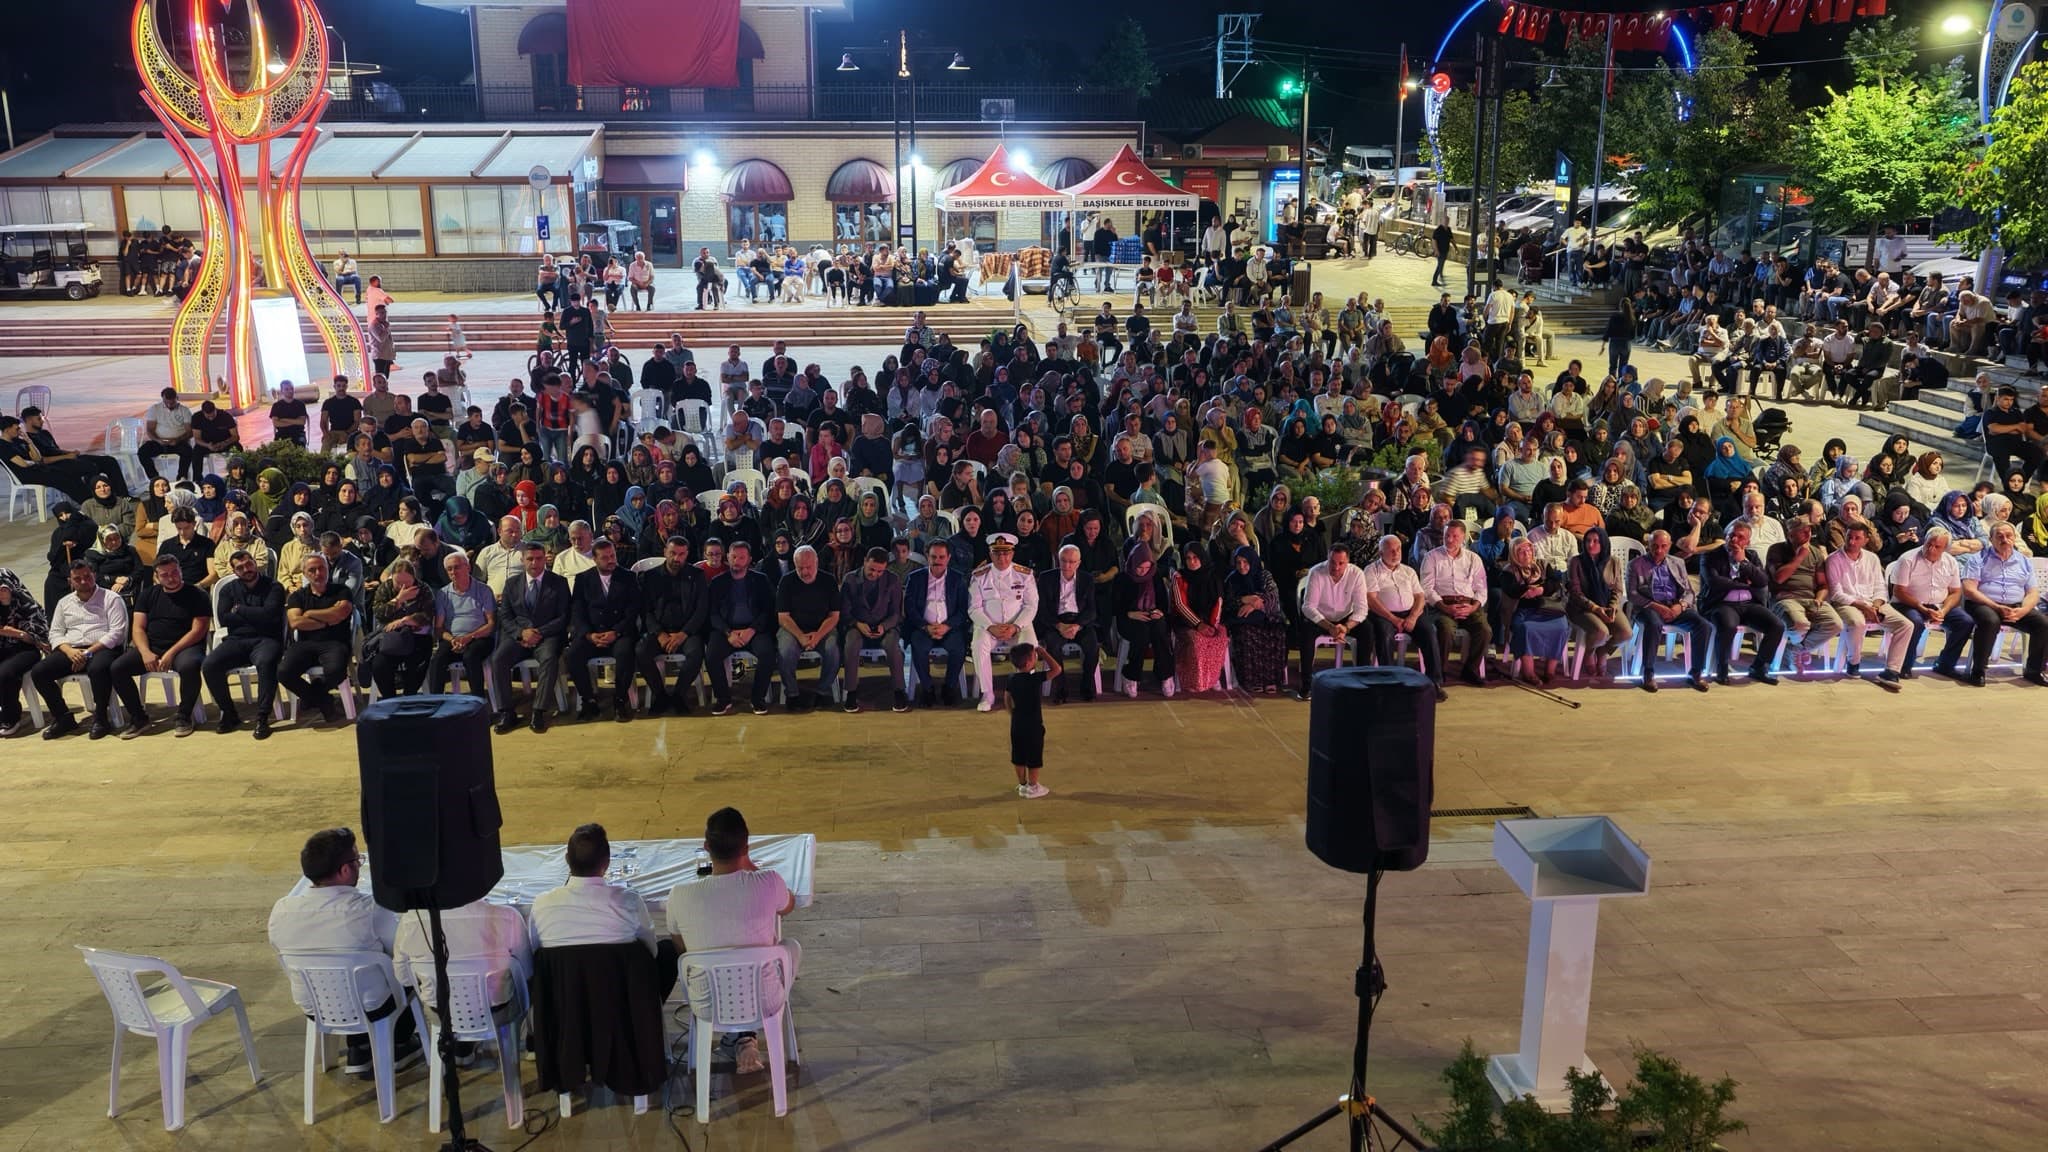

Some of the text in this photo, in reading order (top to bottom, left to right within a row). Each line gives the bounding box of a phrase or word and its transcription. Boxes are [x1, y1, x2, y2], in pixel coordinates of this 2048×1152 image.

[955, 200, 1064, 209] BAŞİSKELE BELEDİYESİ
[1083, 199, 1190, 208] BAŞİSKELE BELEDİYESİ
